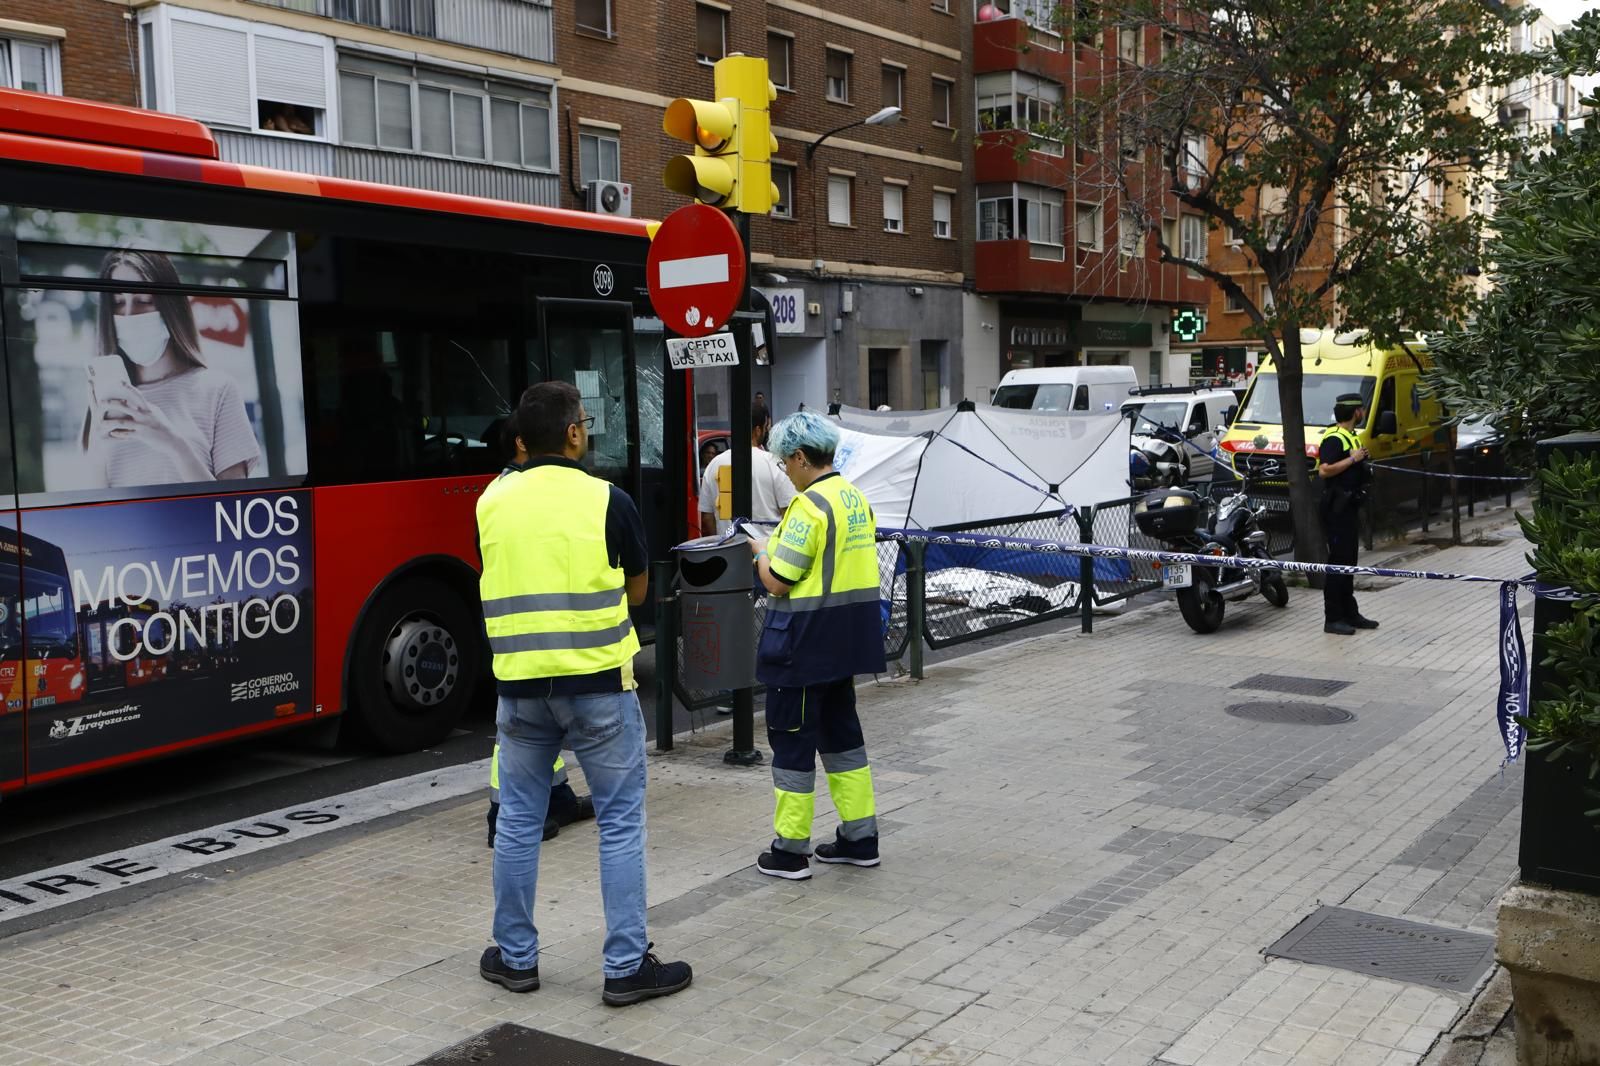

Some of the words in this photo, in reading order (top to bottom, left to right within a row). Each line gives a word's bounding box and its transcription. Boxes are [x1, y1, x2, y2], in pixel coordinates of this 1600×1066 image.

[595, 270, 611, 290] 3098
[773, 294, 796, 324] 208
[672, 338, 727, 351] CEPTO
[708, 352, 734, 363] TAXI
[215, 496, 299, 542] NOS
[788, 517, 812, 535] 061
[783, 530, 807, 546] salud
[73, 545, 300, 613] MOVEMOS
[1169, 575, 1184, 584] FHD
[108, 594, 300, 661] CONTIGO
[248, 672, 293, 690] GOBIERNO
[248, 688, 260, 699] DE
[1505, 692, 1520, 713] NO
[86, 704, 141, 721] automoviles
[67, 713, 141, 737] Zaragoza.com
[0, 857, 158, 912] IRE
[171, 810, 341, 856] BUS
